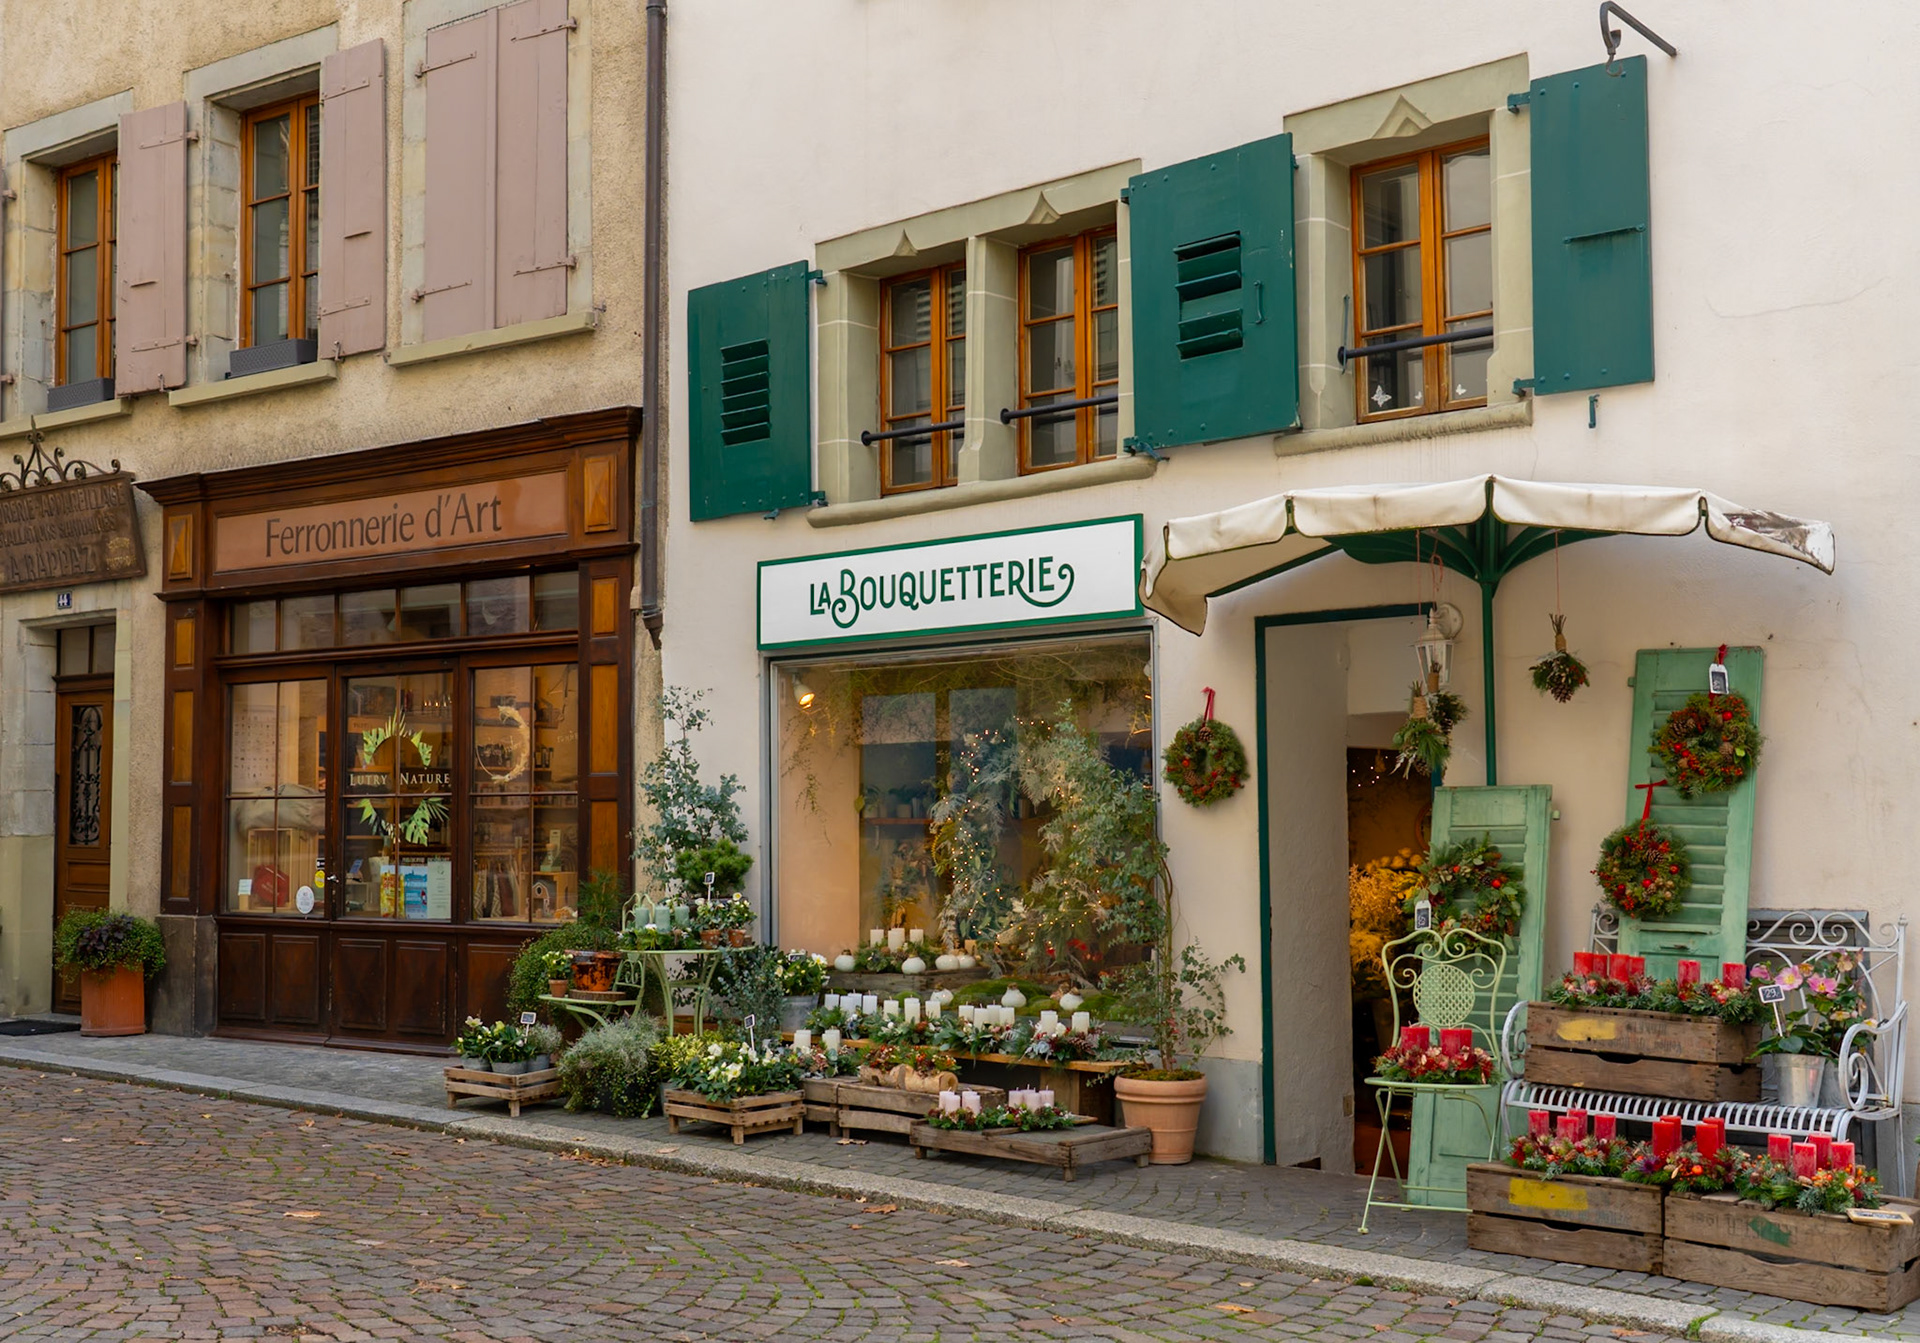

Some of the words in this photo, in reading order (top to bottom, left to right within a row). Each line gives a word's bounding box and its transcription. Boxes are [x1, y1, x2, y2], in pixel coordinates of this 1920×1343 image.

[265, 502, 415, 558] Ferronnerie
[425, 492, 503, 538] d'Art
[58, 593, 69, 607] 44
[810, 581, 831, 616] LA
[831, 556, 1076, 629] BOUQUETTERIE
[349, 773, 388, 787] LUTRY
[400, 771, 450, 785] NATURE
